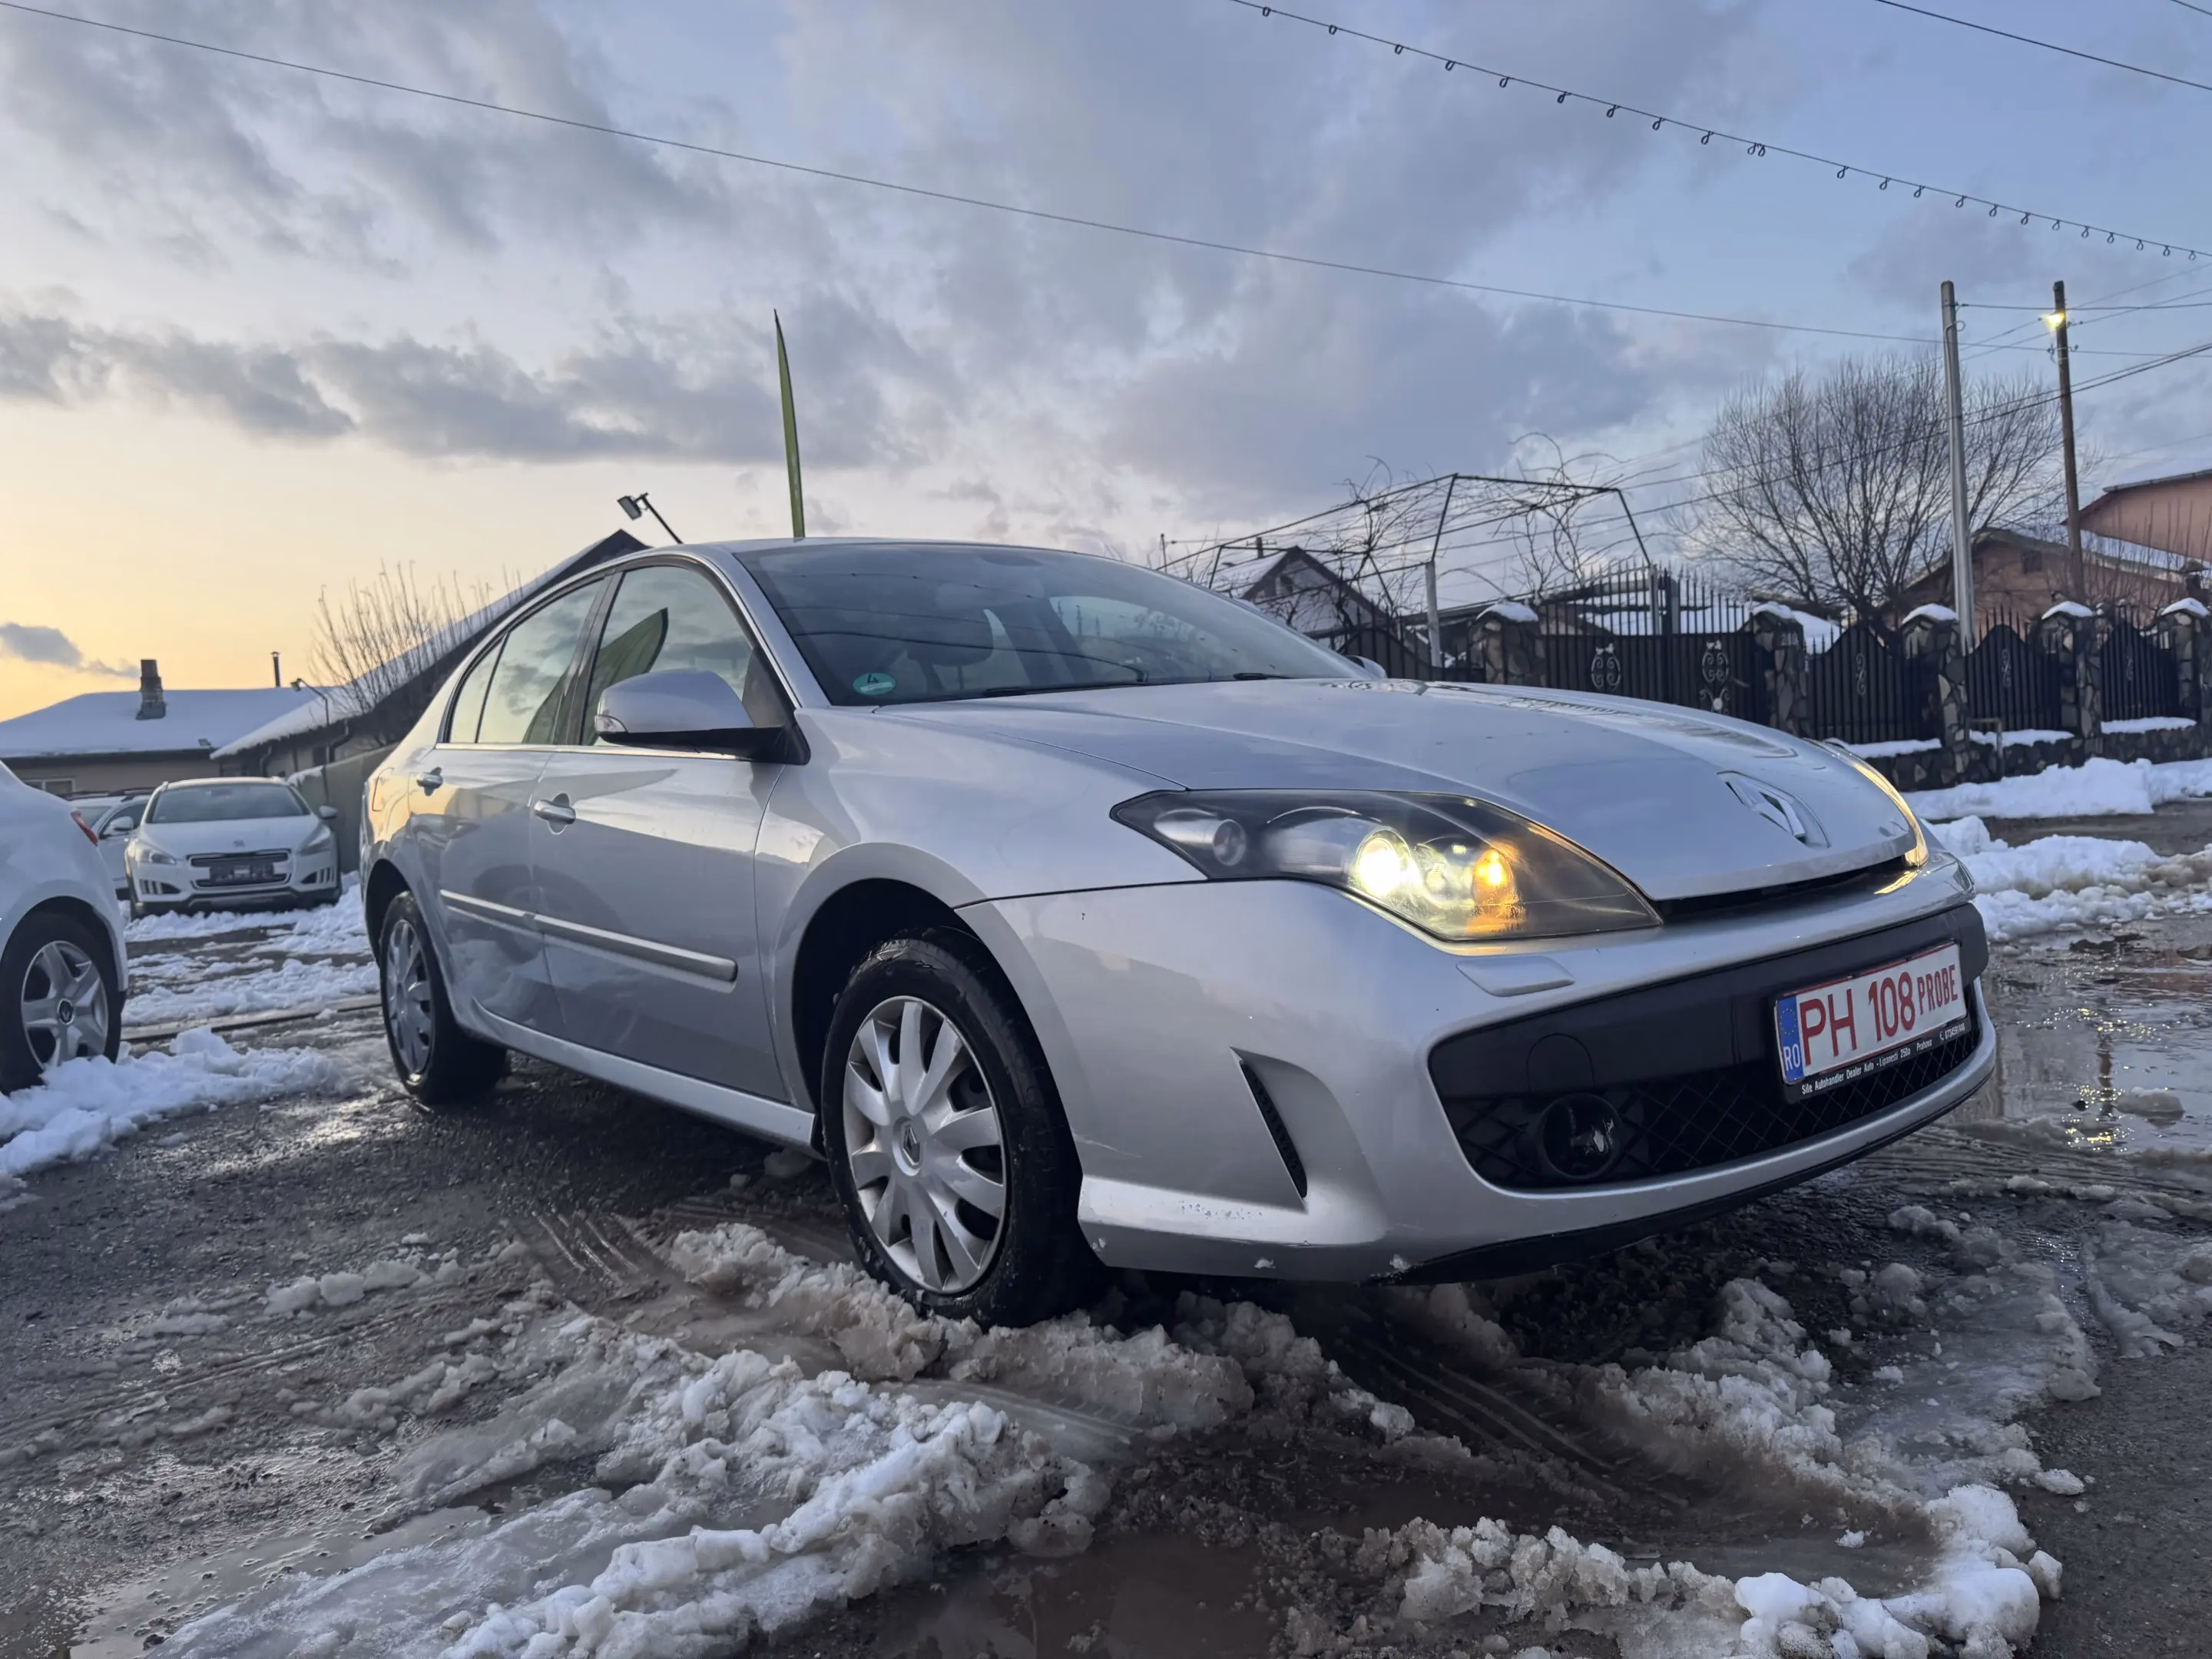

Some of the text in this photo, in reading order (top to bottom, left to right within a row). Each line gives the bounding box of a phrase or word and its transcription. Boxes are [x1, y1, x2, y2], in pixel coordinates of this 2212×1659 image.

[1800, 963, 1958, 1066] PH 108 PROBE
[1783, 1043, 1800, 1071] RO
[1814, 1072, 1844, 1091] Autohandler
[1846, 1066, 1862, 1079] Dealer
[1864, 1061, 1874, 1073] Auto
